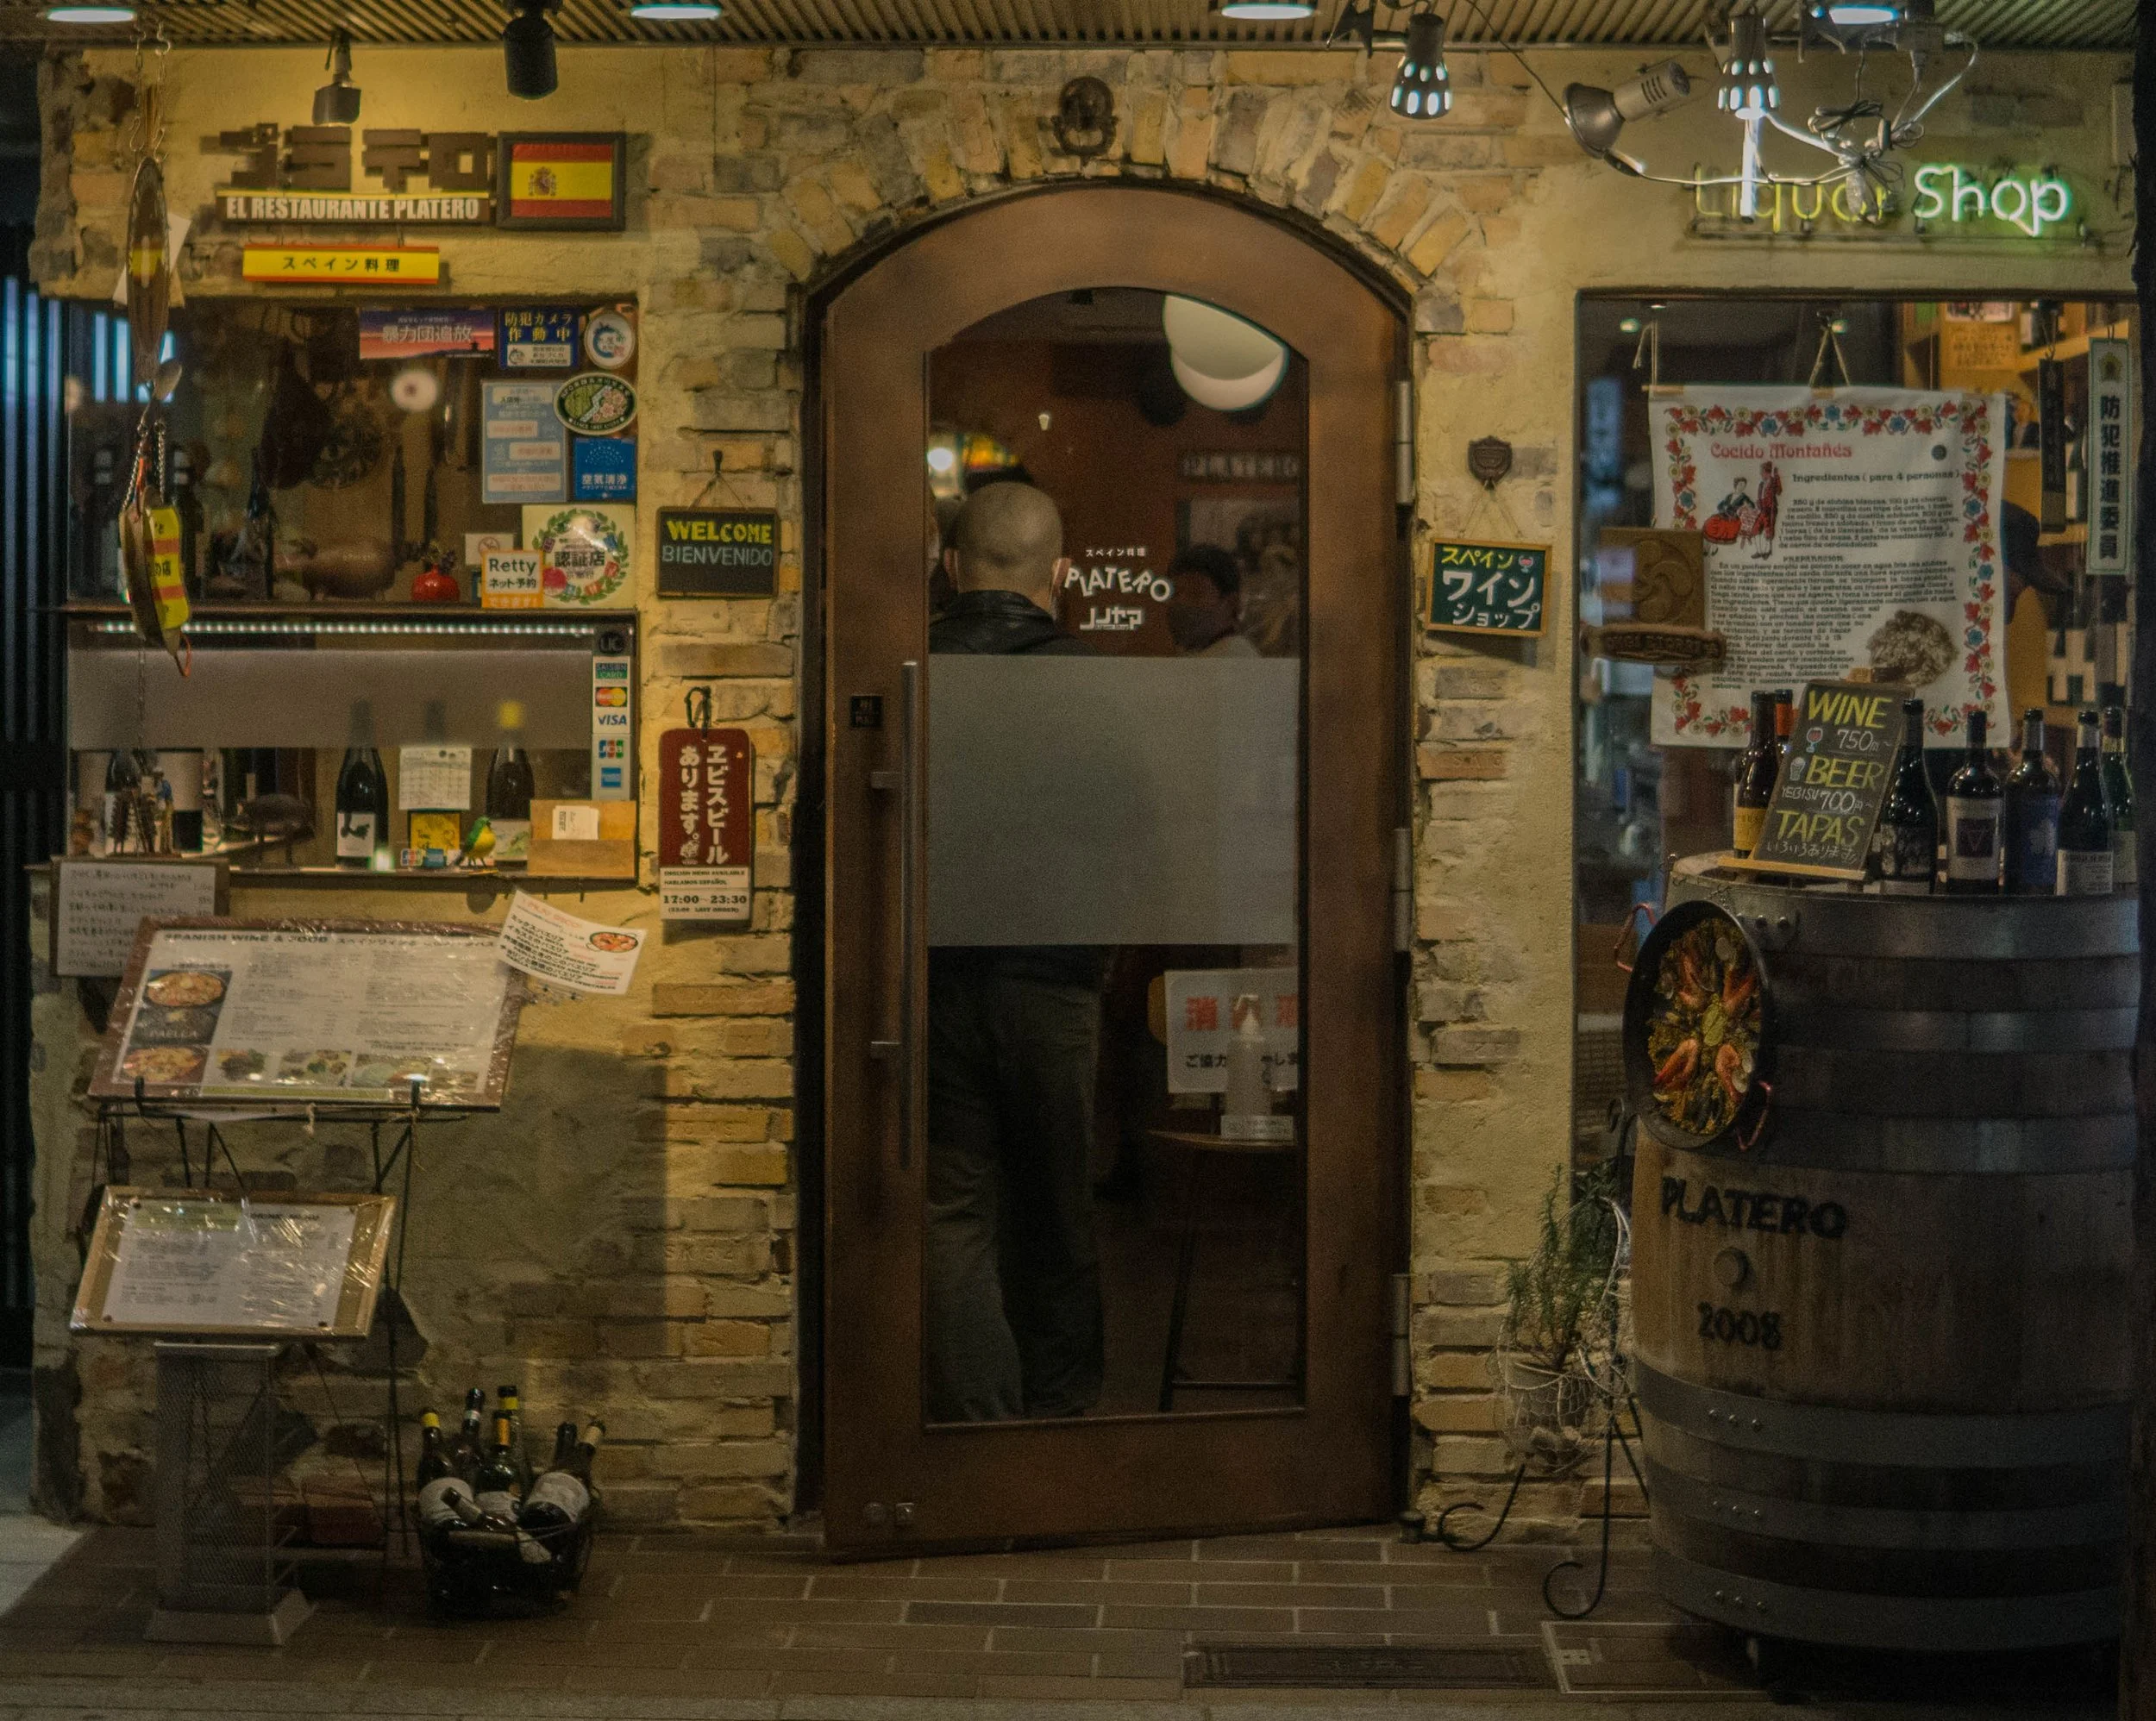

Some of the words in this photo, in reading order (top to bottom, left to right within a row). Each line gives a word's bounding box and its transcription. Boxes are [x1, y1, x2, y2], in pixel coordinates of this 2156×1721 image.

[226, 197, 247, 220] EL
[250, 197, 391, 220] RESTAURANTE
[392, 198, 479, 221] PLATERO
[1914, 165, 2070, 237] Shop
[283, 257, 400, 272] スペイン料理
[505, 310, 572, 327] 防犯カメラ
[509, 327, 571, 341] 作動中
[1710, 441, 1764, 460] Cocido
[1792, 472, 1860, 484] Ingredientes
[2099, 394, 2121, 560] 防犯推進委員
[666, 520, 773, 545] WELCOME
[661, 544, 773, 567] BIENVENIDO
[1086, 548, 1147, 557] スペイン料理
[1441, 546, 1514, 570] スペイン
[488, 558, 537, 576] Retty
[488, 577, 537, 590] ネット予約
[1064, 566, 1172, 603] PLATERO
[1442, 571, 1535, 608] ワイン
[1452, 602, 1541, 630] ショップ
[598, 715, 628, 725] VISA
[1808, 690, 1892, 729] WINE
[1805, 754, 1885, 790] BEER
[1782, 786, 1820, 801] YEBISU
[1776, 810, 1865, 848] TAPAS
[1661, 1175, 1847, 1239] PLATERO
[1698, 1300, 1783, 1351] 2008
